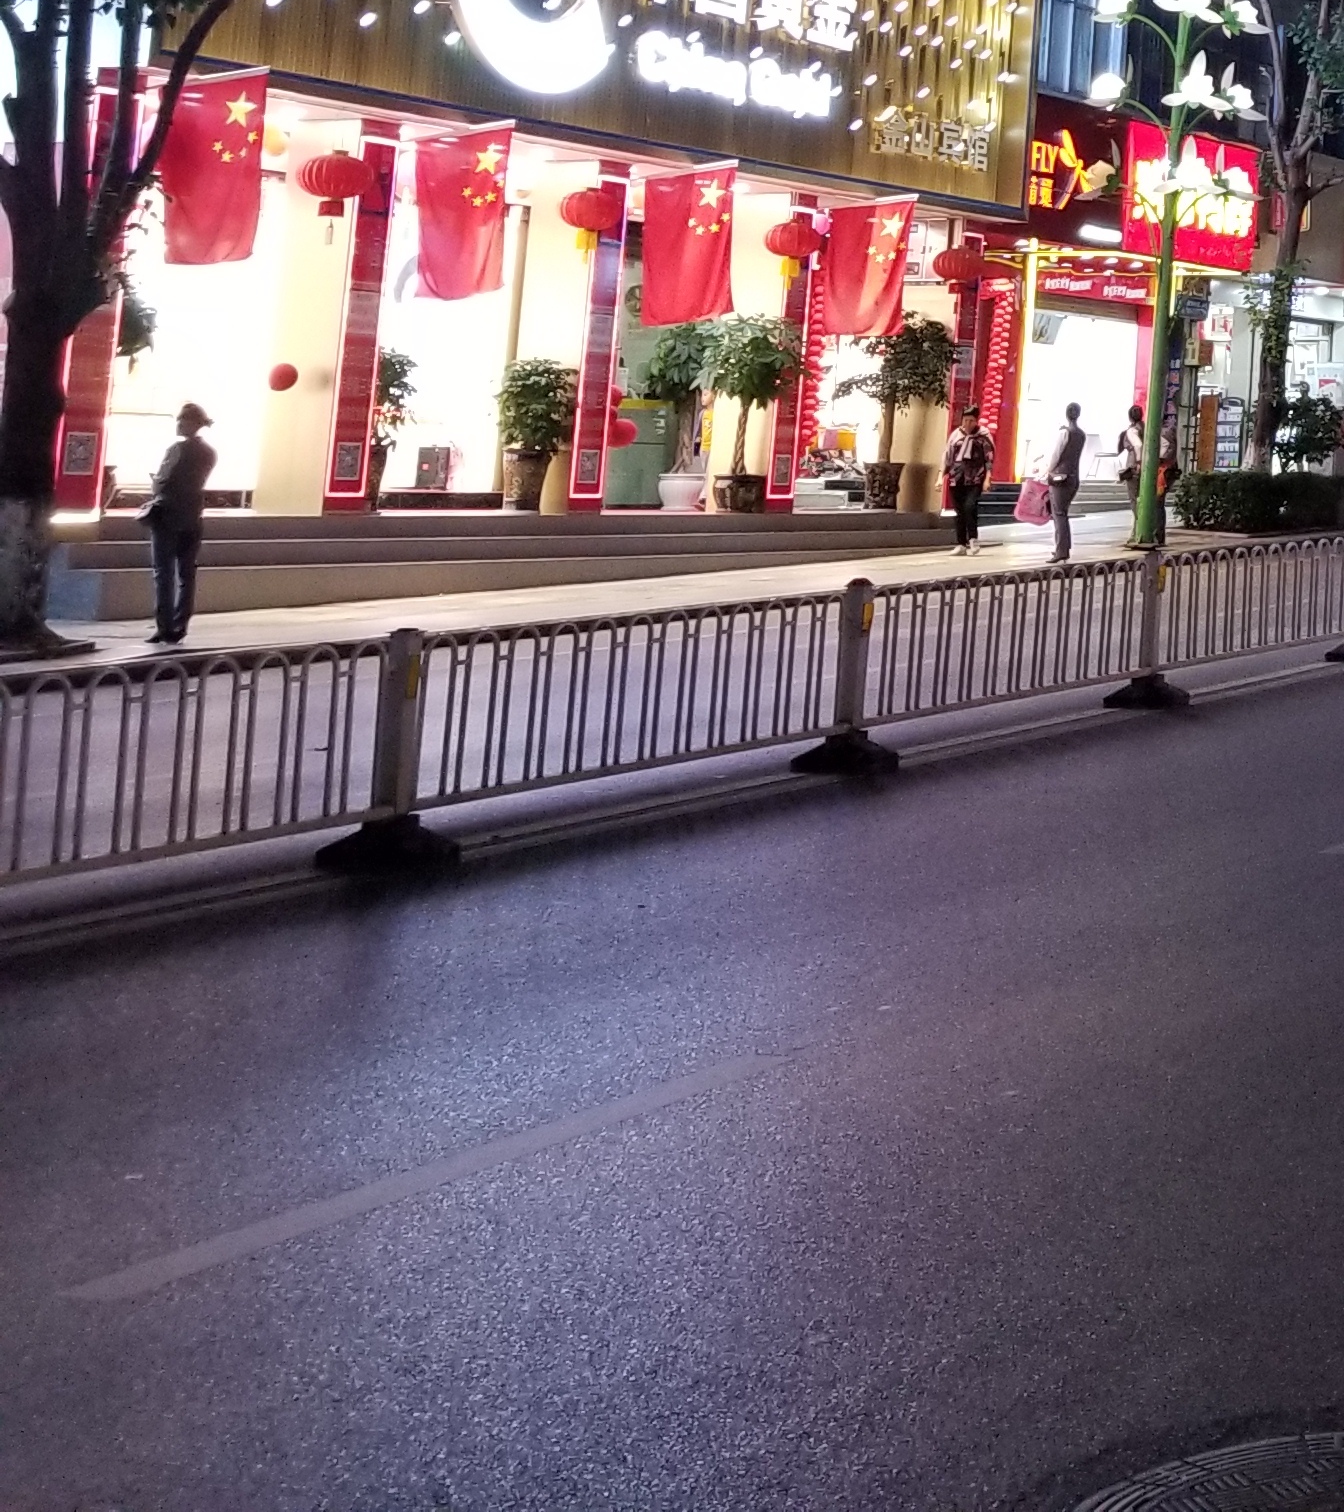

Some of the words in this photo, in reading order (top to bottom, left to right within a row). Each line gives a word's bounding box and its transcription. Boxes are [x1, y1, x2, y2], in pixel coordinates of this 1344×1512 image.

[874, 105, 990, 172] 金山宾馆
[1031, 141, 1059, 173] FLY
